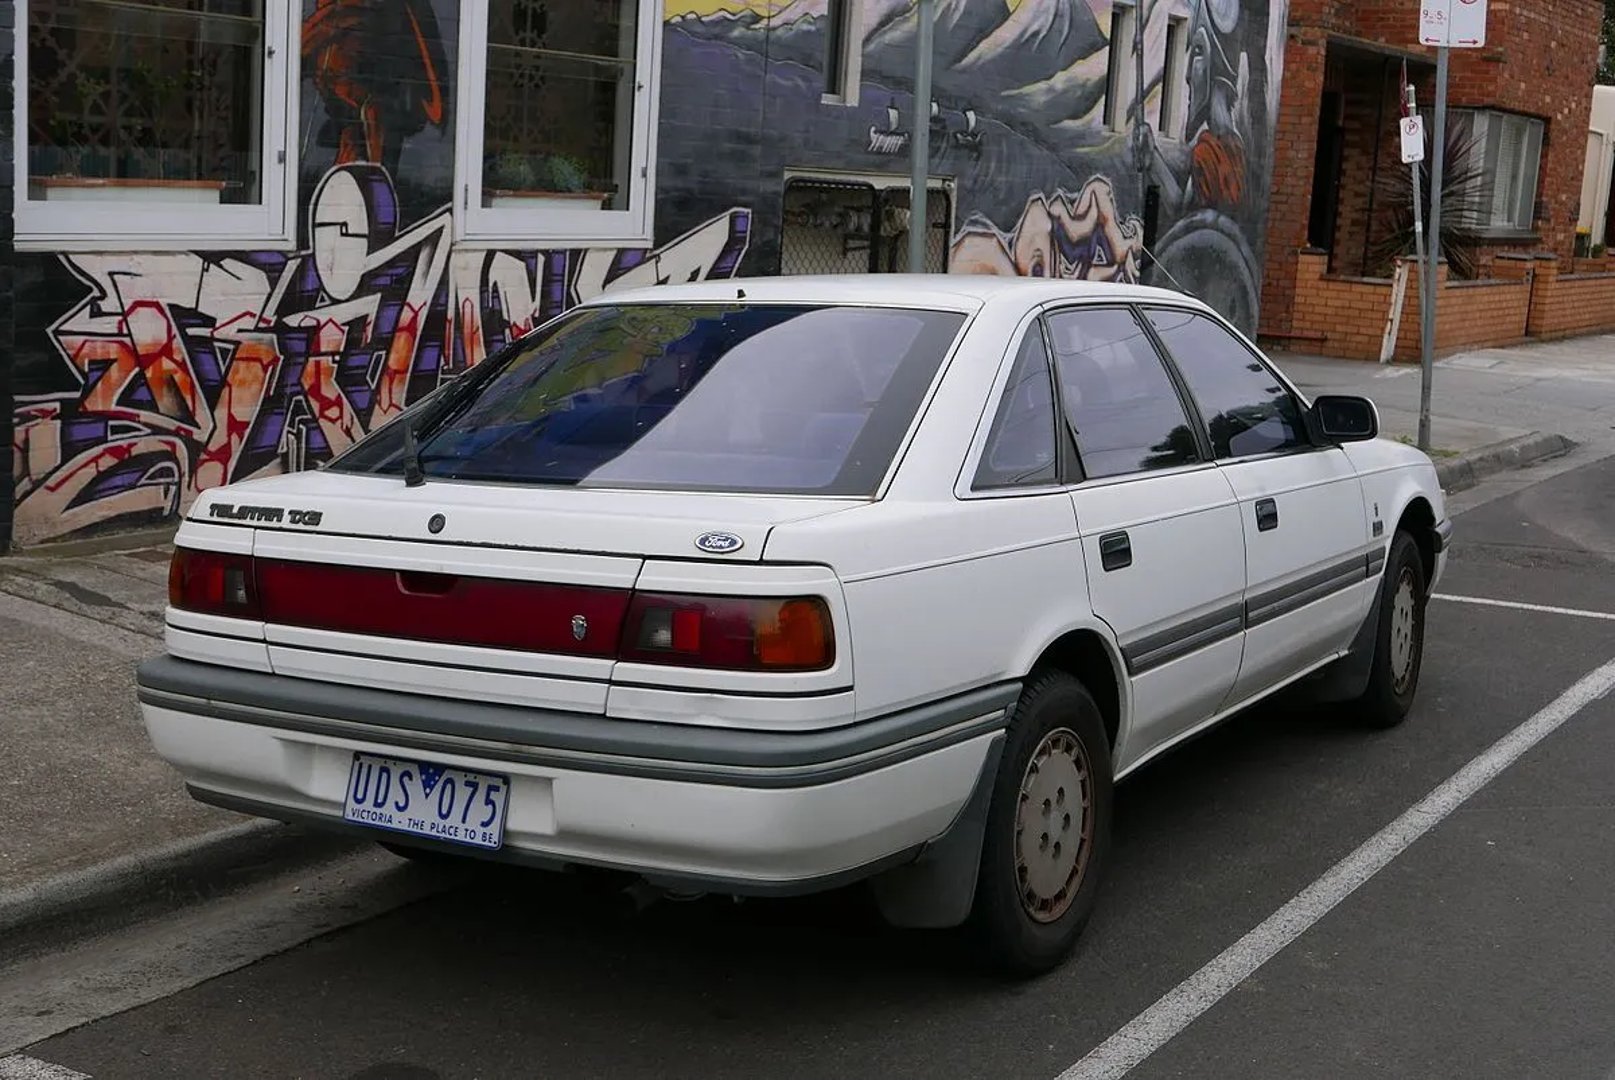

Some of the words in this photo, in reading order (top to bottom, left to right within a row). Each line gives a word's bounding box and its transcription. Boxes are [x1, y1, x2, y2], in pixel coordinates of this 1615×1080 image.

[353, 762, 413, 812] UDS
[437, 777, 500, 828] 075
[351, 807, 393, 825] VICTORIA
[407, 817, 425, 831] THE
[430, 822, 459, 837] PLACE
[464, 827, 477, 840] TO
